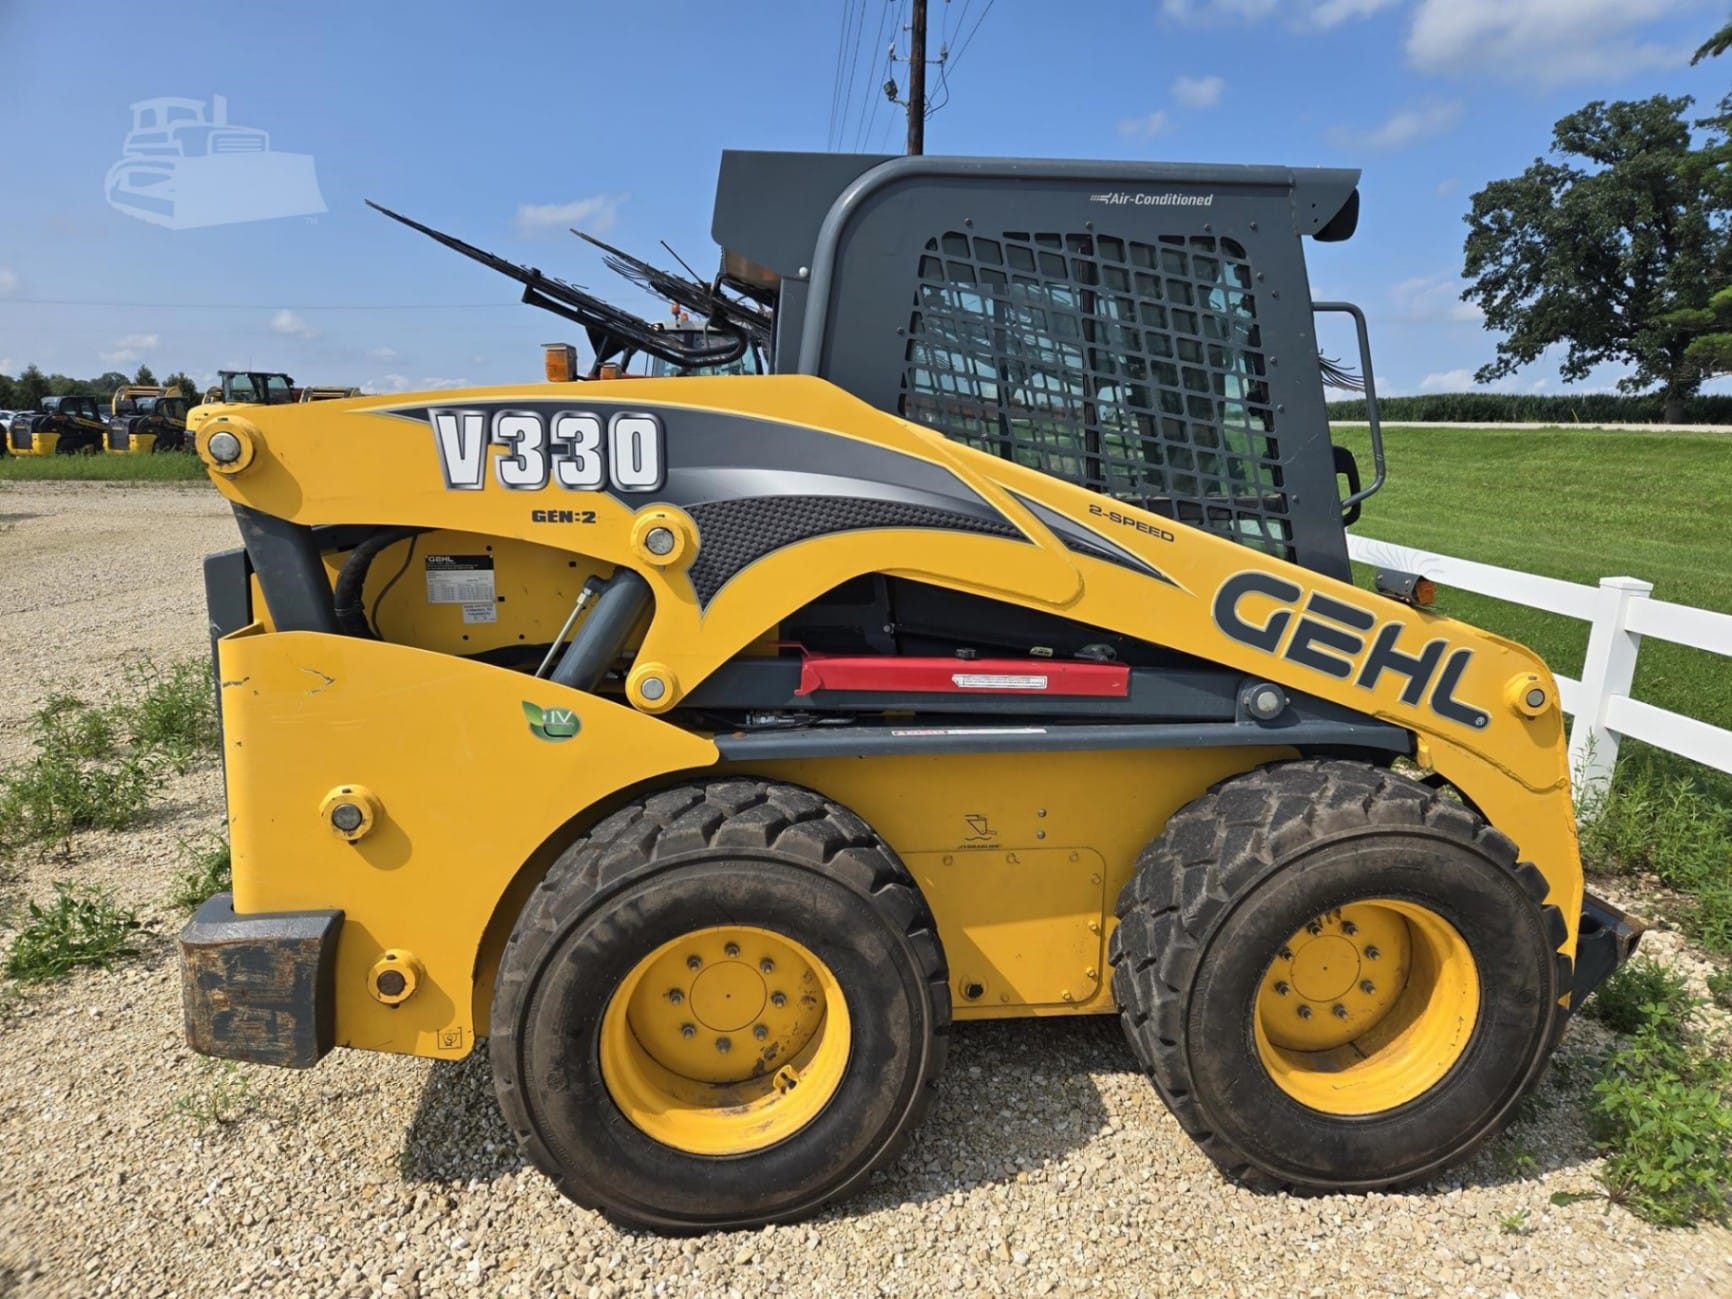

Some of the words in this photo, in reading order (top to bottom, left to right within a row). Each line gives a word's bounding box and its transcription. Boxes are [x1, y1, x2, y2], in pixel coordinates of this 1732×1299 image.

[1110, 193, 1214, 206] Air-Conditioned
[428, 408, 666, 490] V330
[532, 509, 596, 524] GEN:2
[1089, 504, 1175, 542] 2-SPEED
[1212, 570, 1490, 729] GEHL
